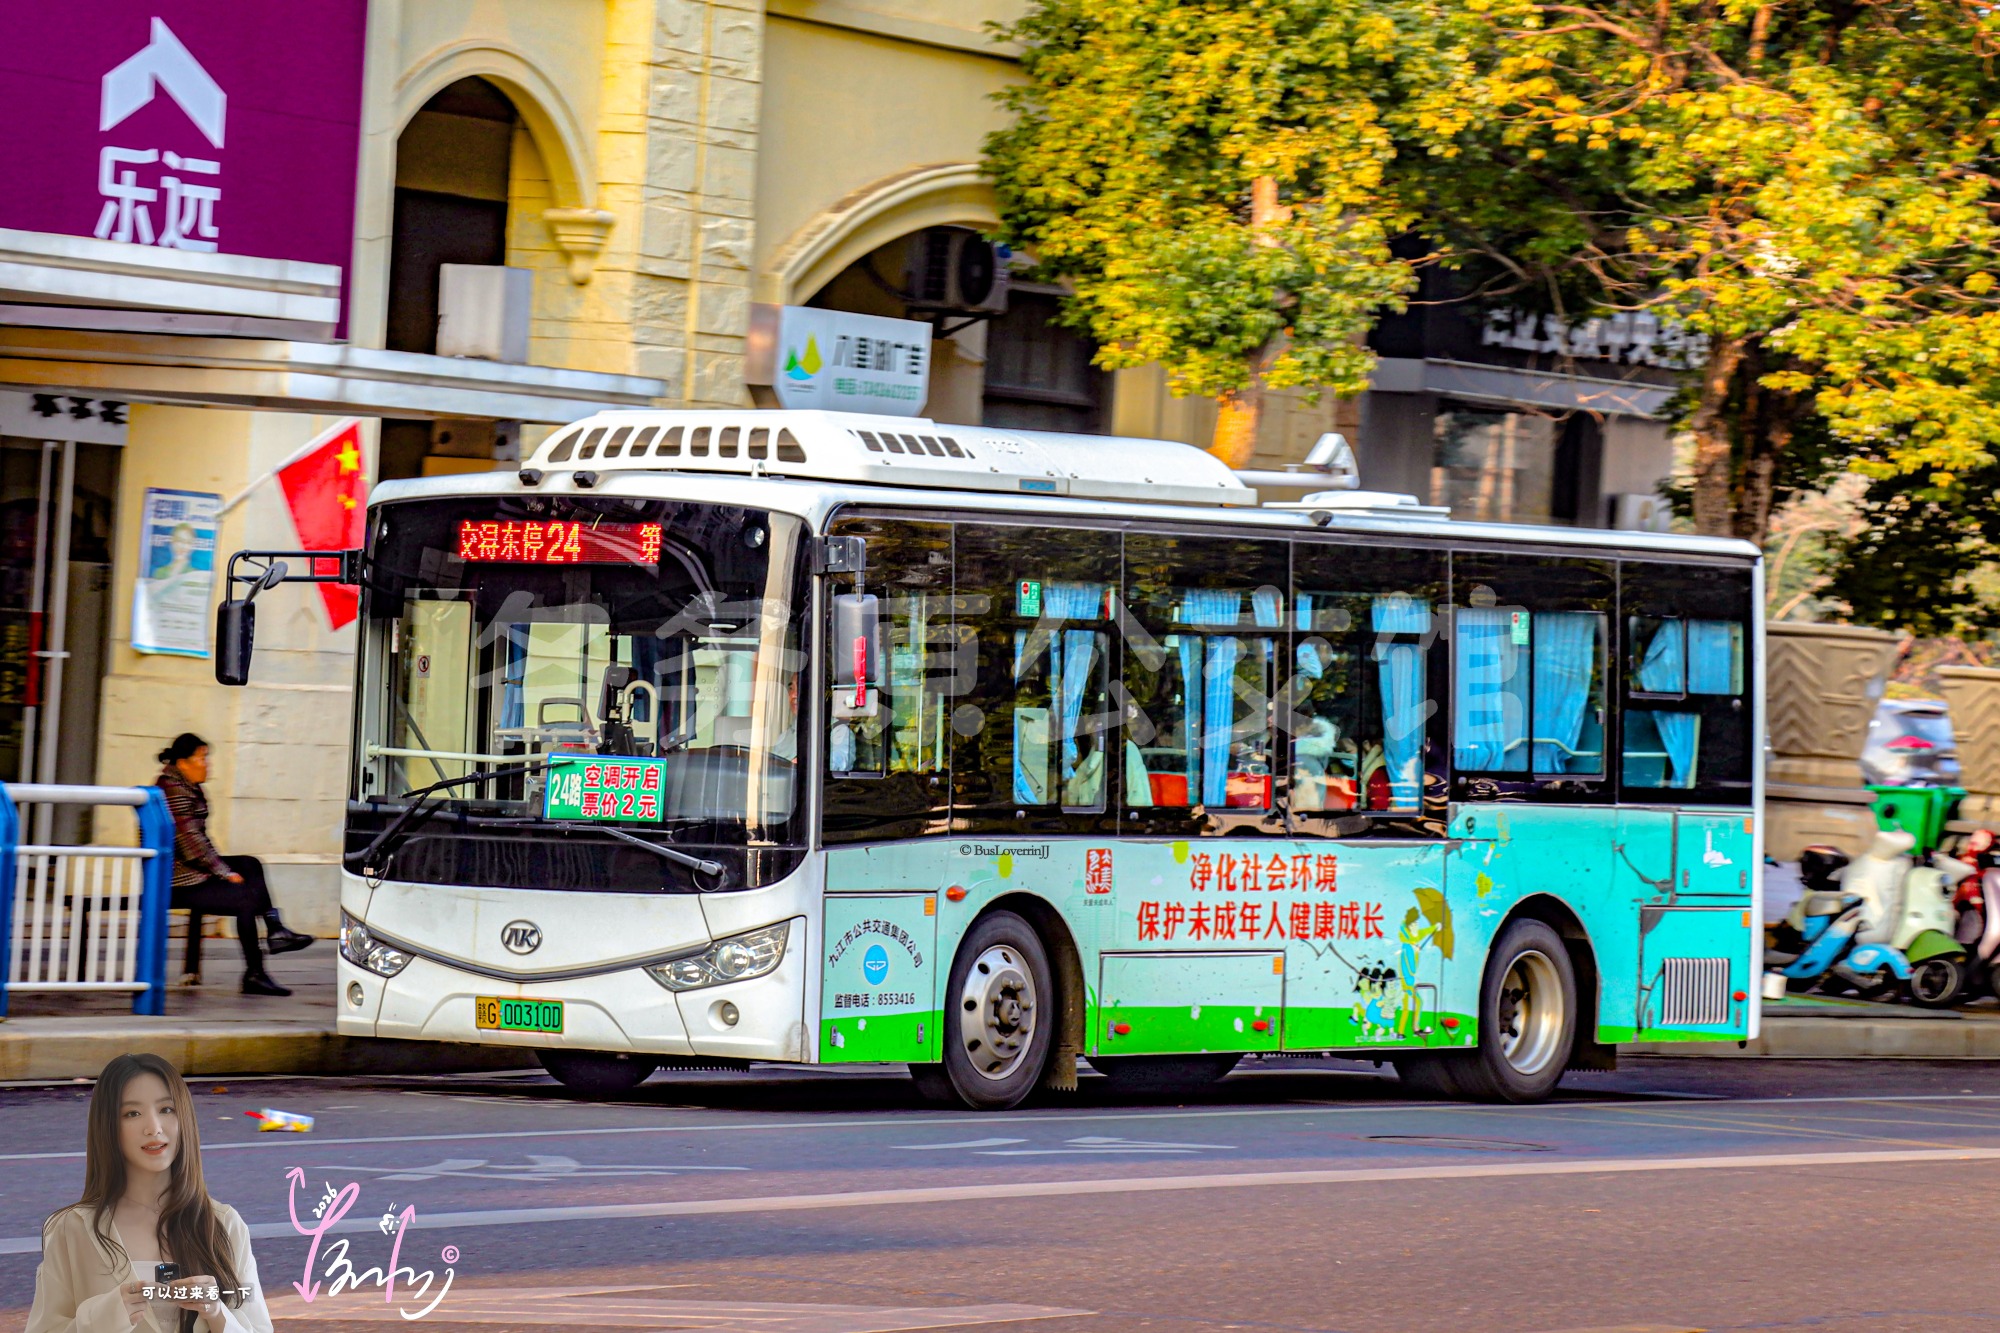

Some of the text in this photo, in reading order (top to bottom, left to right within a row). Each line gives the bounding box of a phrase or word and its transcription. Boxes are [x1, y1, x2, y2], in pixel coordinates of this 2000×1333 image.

[93, 146, 221, 252] 乐远
[551, 773, 582, 806] 24路
[584, 764, 660, 790] 空调开启
[581, 791, 657, 818] 票价2元
[1190, 853, 1338, 892] 净化社会环境
[1137, 901, 1384, 940] 保护未成年人健康成长
[828, 919, 924, 968] 九江市公共交通集团公司
